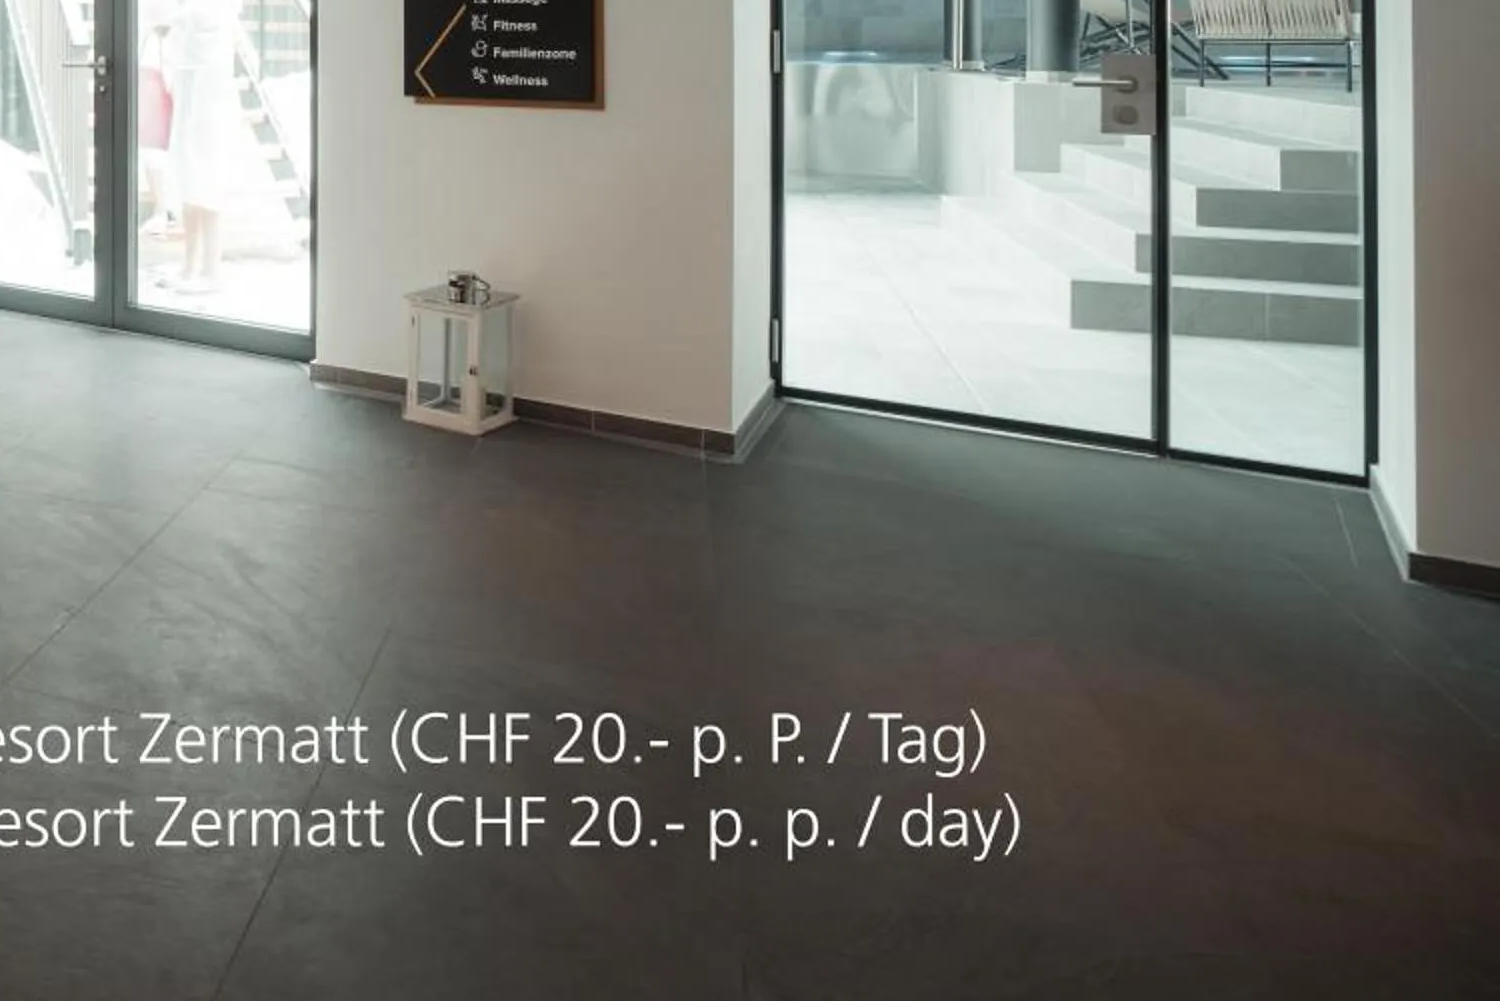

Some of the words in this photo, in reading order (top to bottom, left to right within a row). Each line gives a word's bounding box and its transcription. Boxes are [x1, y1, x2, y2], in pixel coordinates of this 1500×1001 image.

[493, 19, 538, 32] Fitness
[493, 46, 577, 60] Familienzone
[493, 74, 549, 87] Wellness
